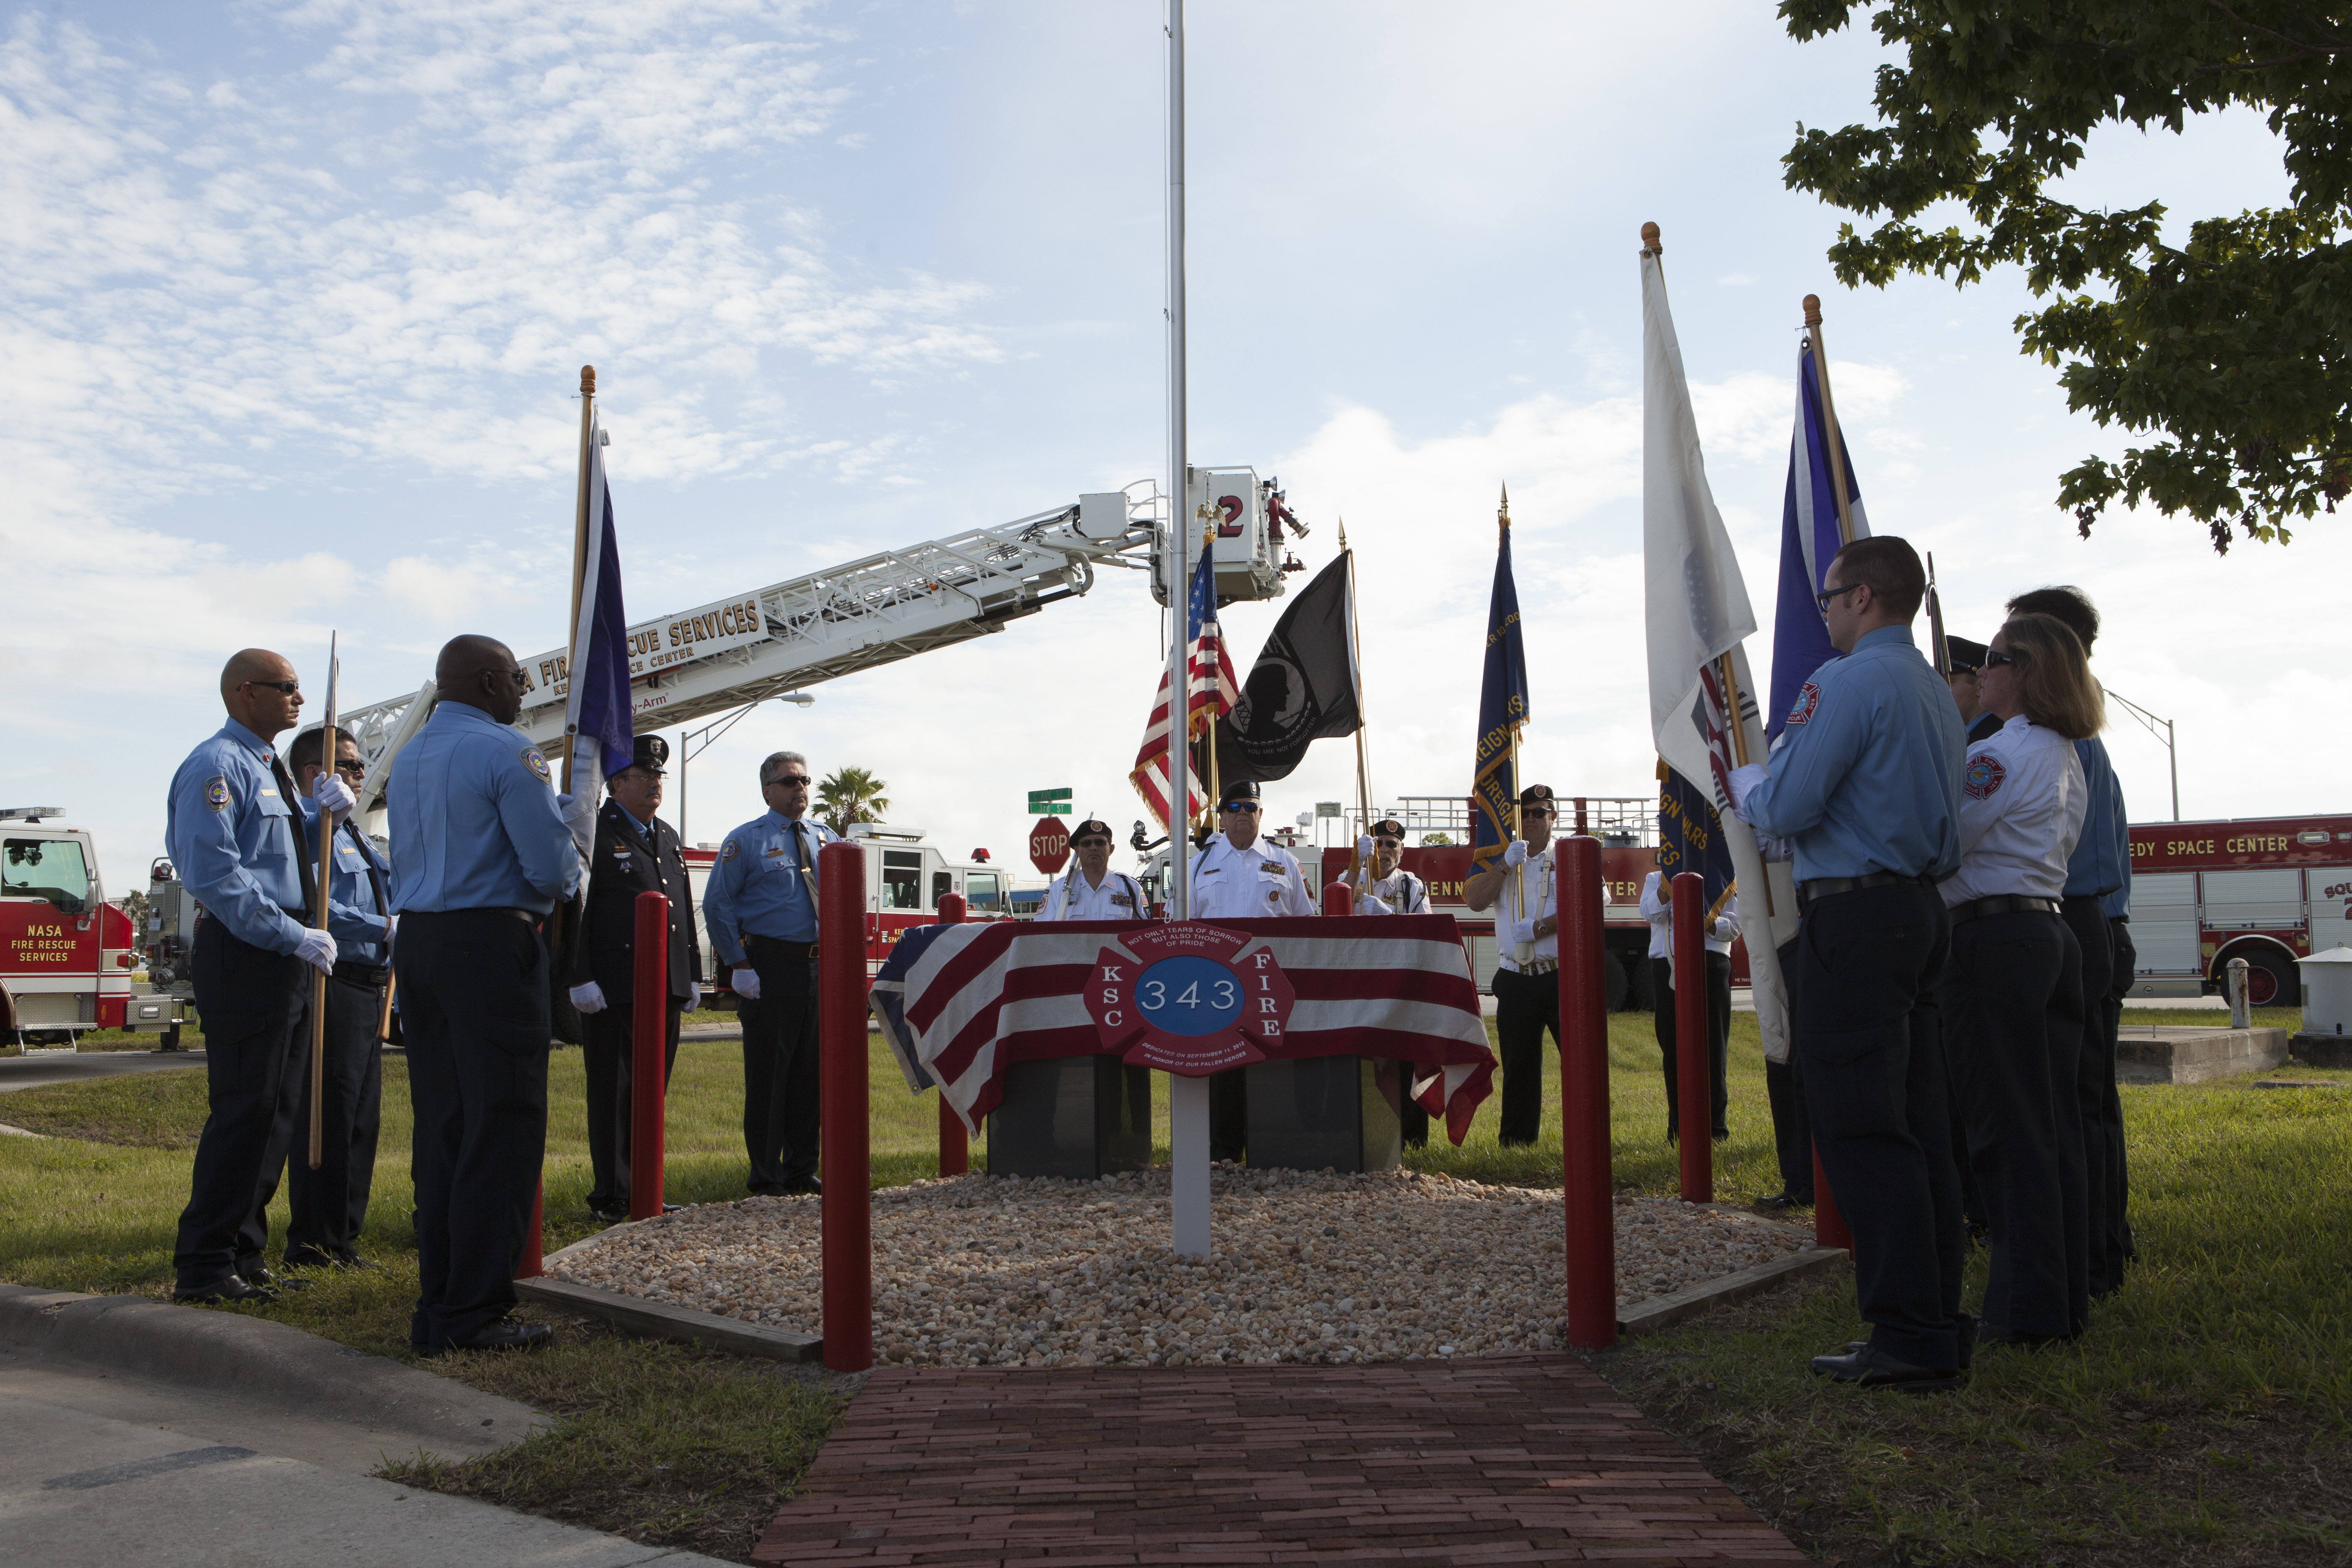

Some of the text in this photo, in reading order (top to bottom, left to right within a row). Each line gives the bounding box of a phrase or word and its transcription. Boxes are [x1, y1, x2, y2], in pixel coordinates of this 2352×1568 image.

[1217, 495, 1244, 538] 2
[539, 656, 567, 686] FIR
[627, 629, 660, 658] CUE
[669, 600, 759, 647] SERVICES
[650, 646, 694, 667] CENTER
[1289, 717, 1316, 748] FORGOTTEN
[1985, 758, 1996, 767] FIRE
[1966, 784, 1979, 793] SCUE
[1989, 780, 1999, 790] KSC
[1041, 791, 1052, 799] AVE
[1056, 790, 1064, 799] SE
[1039, 804, 1064, 813] 3rd ST
[1032, 834, 1068, 857] STOP
[2129, 837, 2288, 857] EDY SPACE CENTER
[1606, 882, 1638, 896] TER
[27, 925, 62, 937] NASA
[1127, 936, 1143, 946] NOT
[1145, 929, 1164, 939] ONLY
[1209, 930, 1243, 945] SORROW
[11, 940, 76, 949] FIRE RESCUE
[1194, 934, 1221, 944] THOSE
[19, 952, 67, 962] SERVICES
[1142, 1042, 1175, 1056] DEDICATED
[1233, 1041, 1245, 1050] 2012
[1152, 1056, 1174, 1065] HONOR
[1224, 1051, 1246, 1063] HEROES
